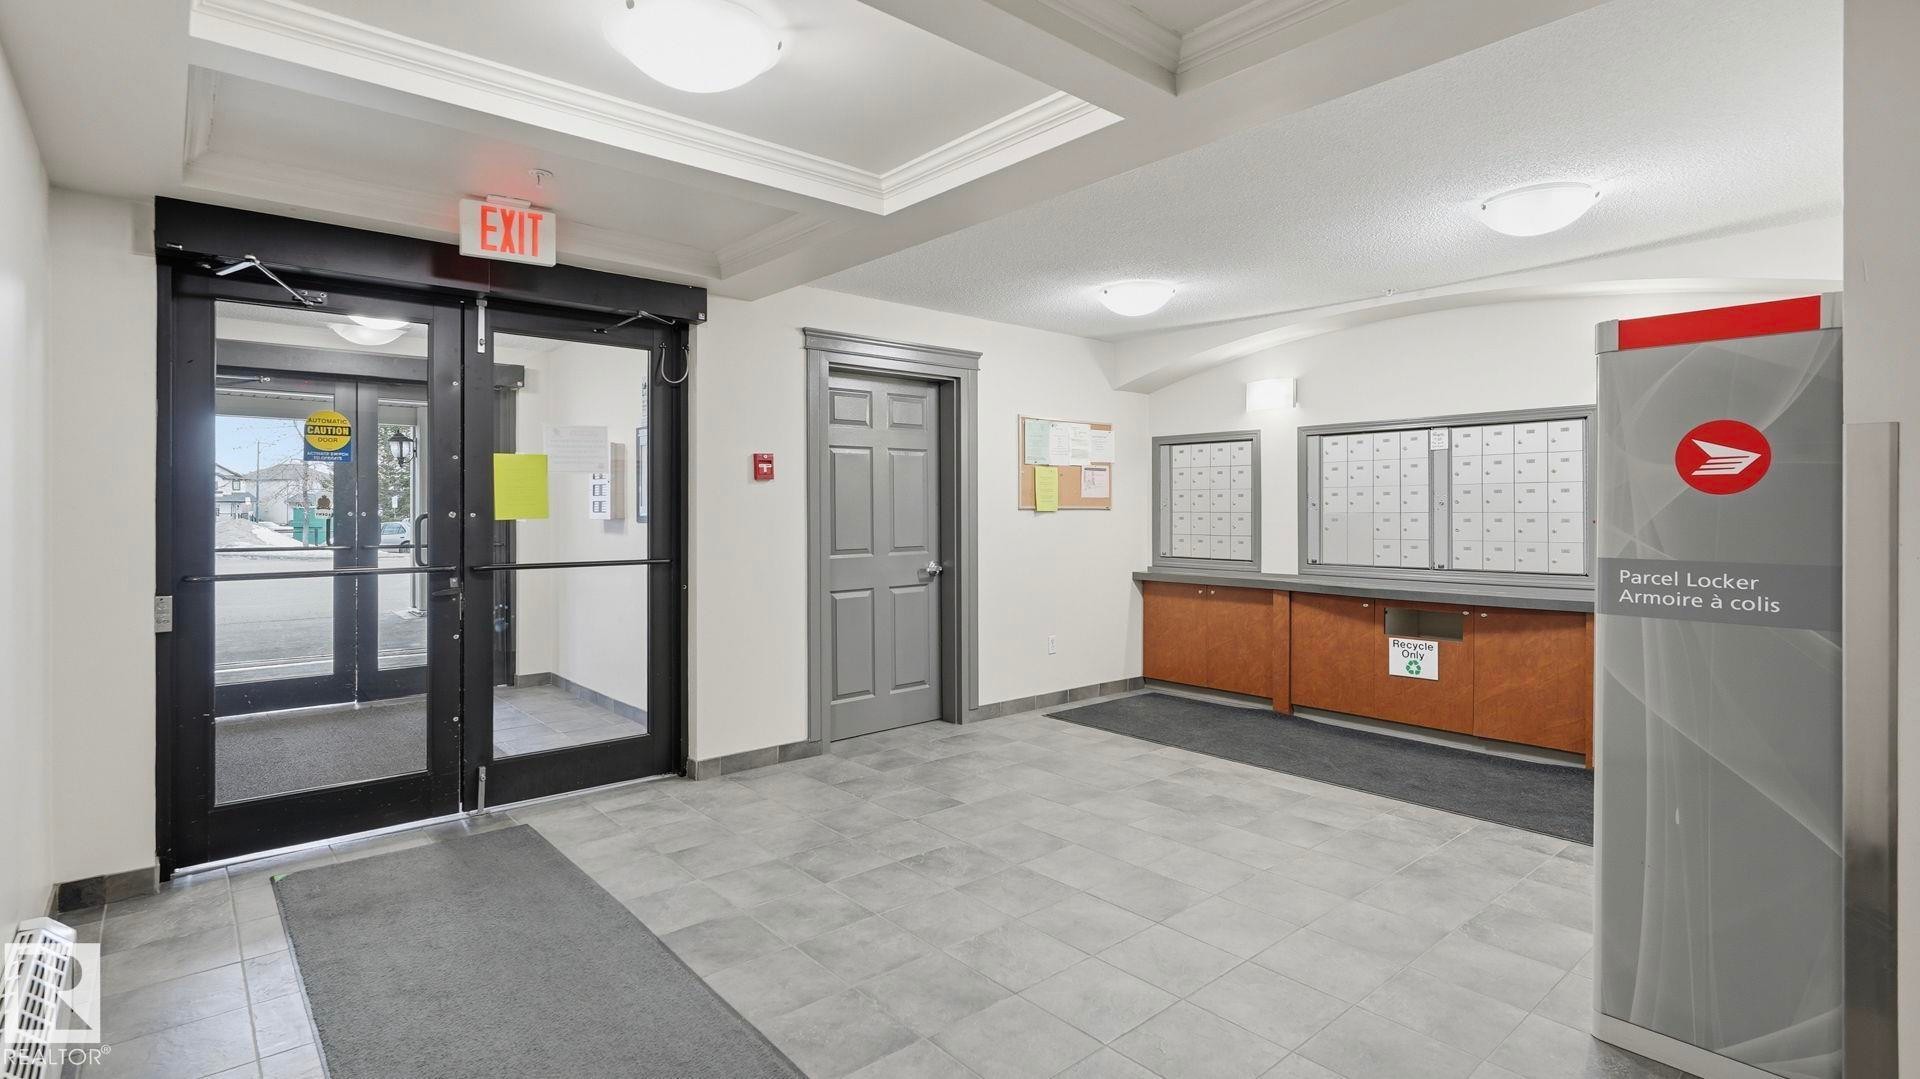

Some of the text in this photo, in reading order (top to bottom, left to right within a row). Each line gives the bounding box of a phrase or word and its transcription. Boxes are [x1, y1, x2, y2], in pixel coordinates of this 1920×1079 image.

[480, 205, 544, 257] EXIT
[308, 416, 348, 425] AUTOMATIC
[306, 425, 350, 436] CAUTION
[1619, 569, 1760, 591] Parcel Locker
[1618, 588, 1782, 614] Armoire à colis
[1392, 639, 1434, 652] Recycle
[1401, 649, 1425, 661] Only
